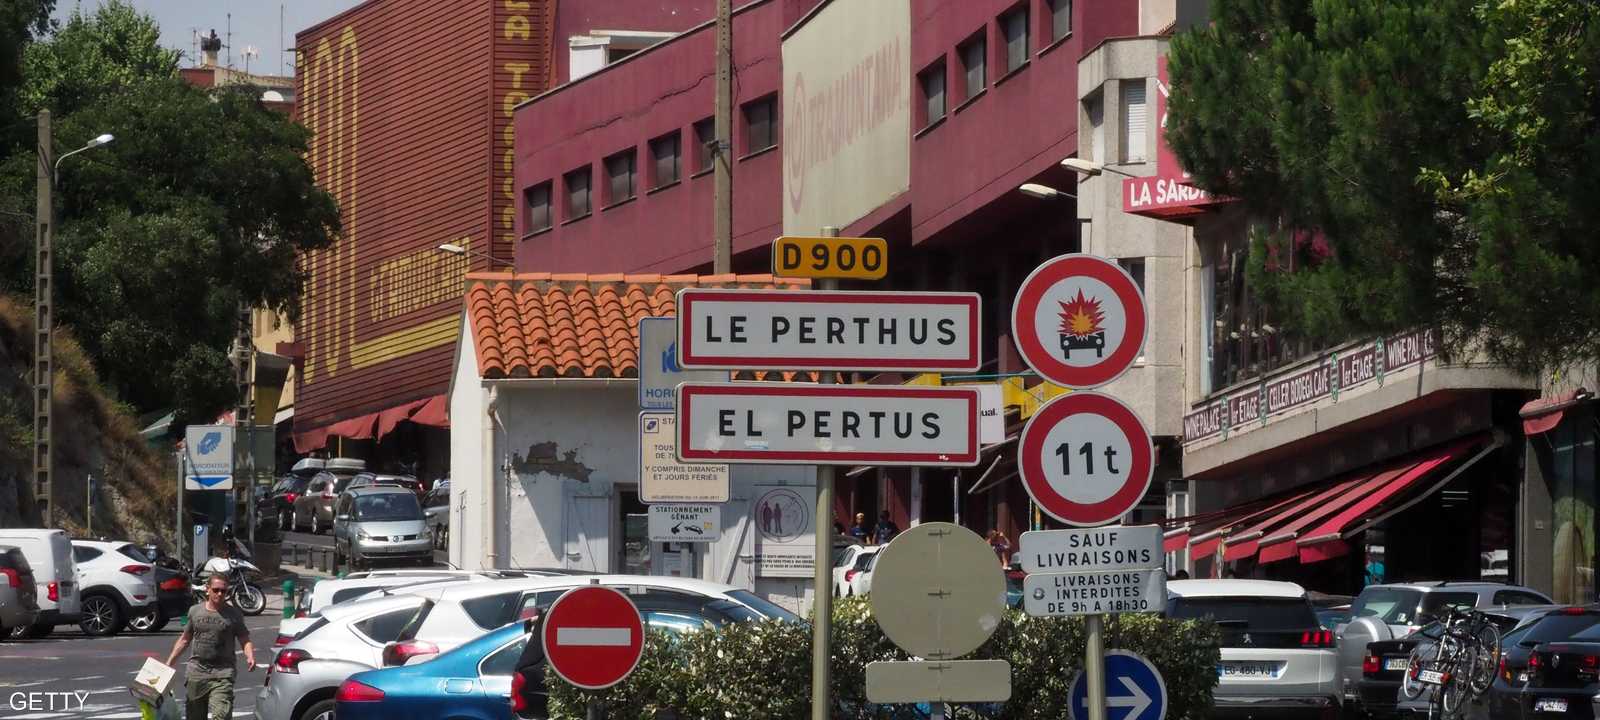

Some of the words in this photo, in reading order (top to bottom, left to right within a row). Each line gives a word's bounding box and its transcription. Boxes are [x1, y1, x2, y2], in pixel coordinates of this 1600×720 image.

[808, 34, 902, 168] TRAMUNTANA
[1131, 182, 1152, 207] LA
[783, 243, 801, 270] D
[811, 243, 881, 272] 900
[706, 316, 747, 343] LE
[771, 316, 956, 345] PERTHUS
[1351, 355, 1373, 383] ÉTAGE
[1269, 382, 1290, 411] CELLER
[1290, 375, 1314, 404] BODEGA
[1239, 397, 1258, 423] ÉTAGE
[719, 409, 762, 437] EL
[787, 410, 941, 439] PERTUS
[1184, 414, 1200, 440] WINE
[1200, 408, 1220, 437] PALACE
[651, 465, 686, 473] COMPRIS
[687, 465, 726, 473] DIMANCHE
[1070, 532, 1118, 548] SAUF
[1037, 549, 1150, 568] LIVRAISONS
[1054, 573, 1140, 587] LIVRAISONS
[1057, 586, 1140, 600] INTERDITES
[1048, 602, 1065, 613] DE
[1072, 601, 1087, 612] 9h
[1094, 602, 1102, 612] A
[1109, 600, 1148, 611] 18h30
